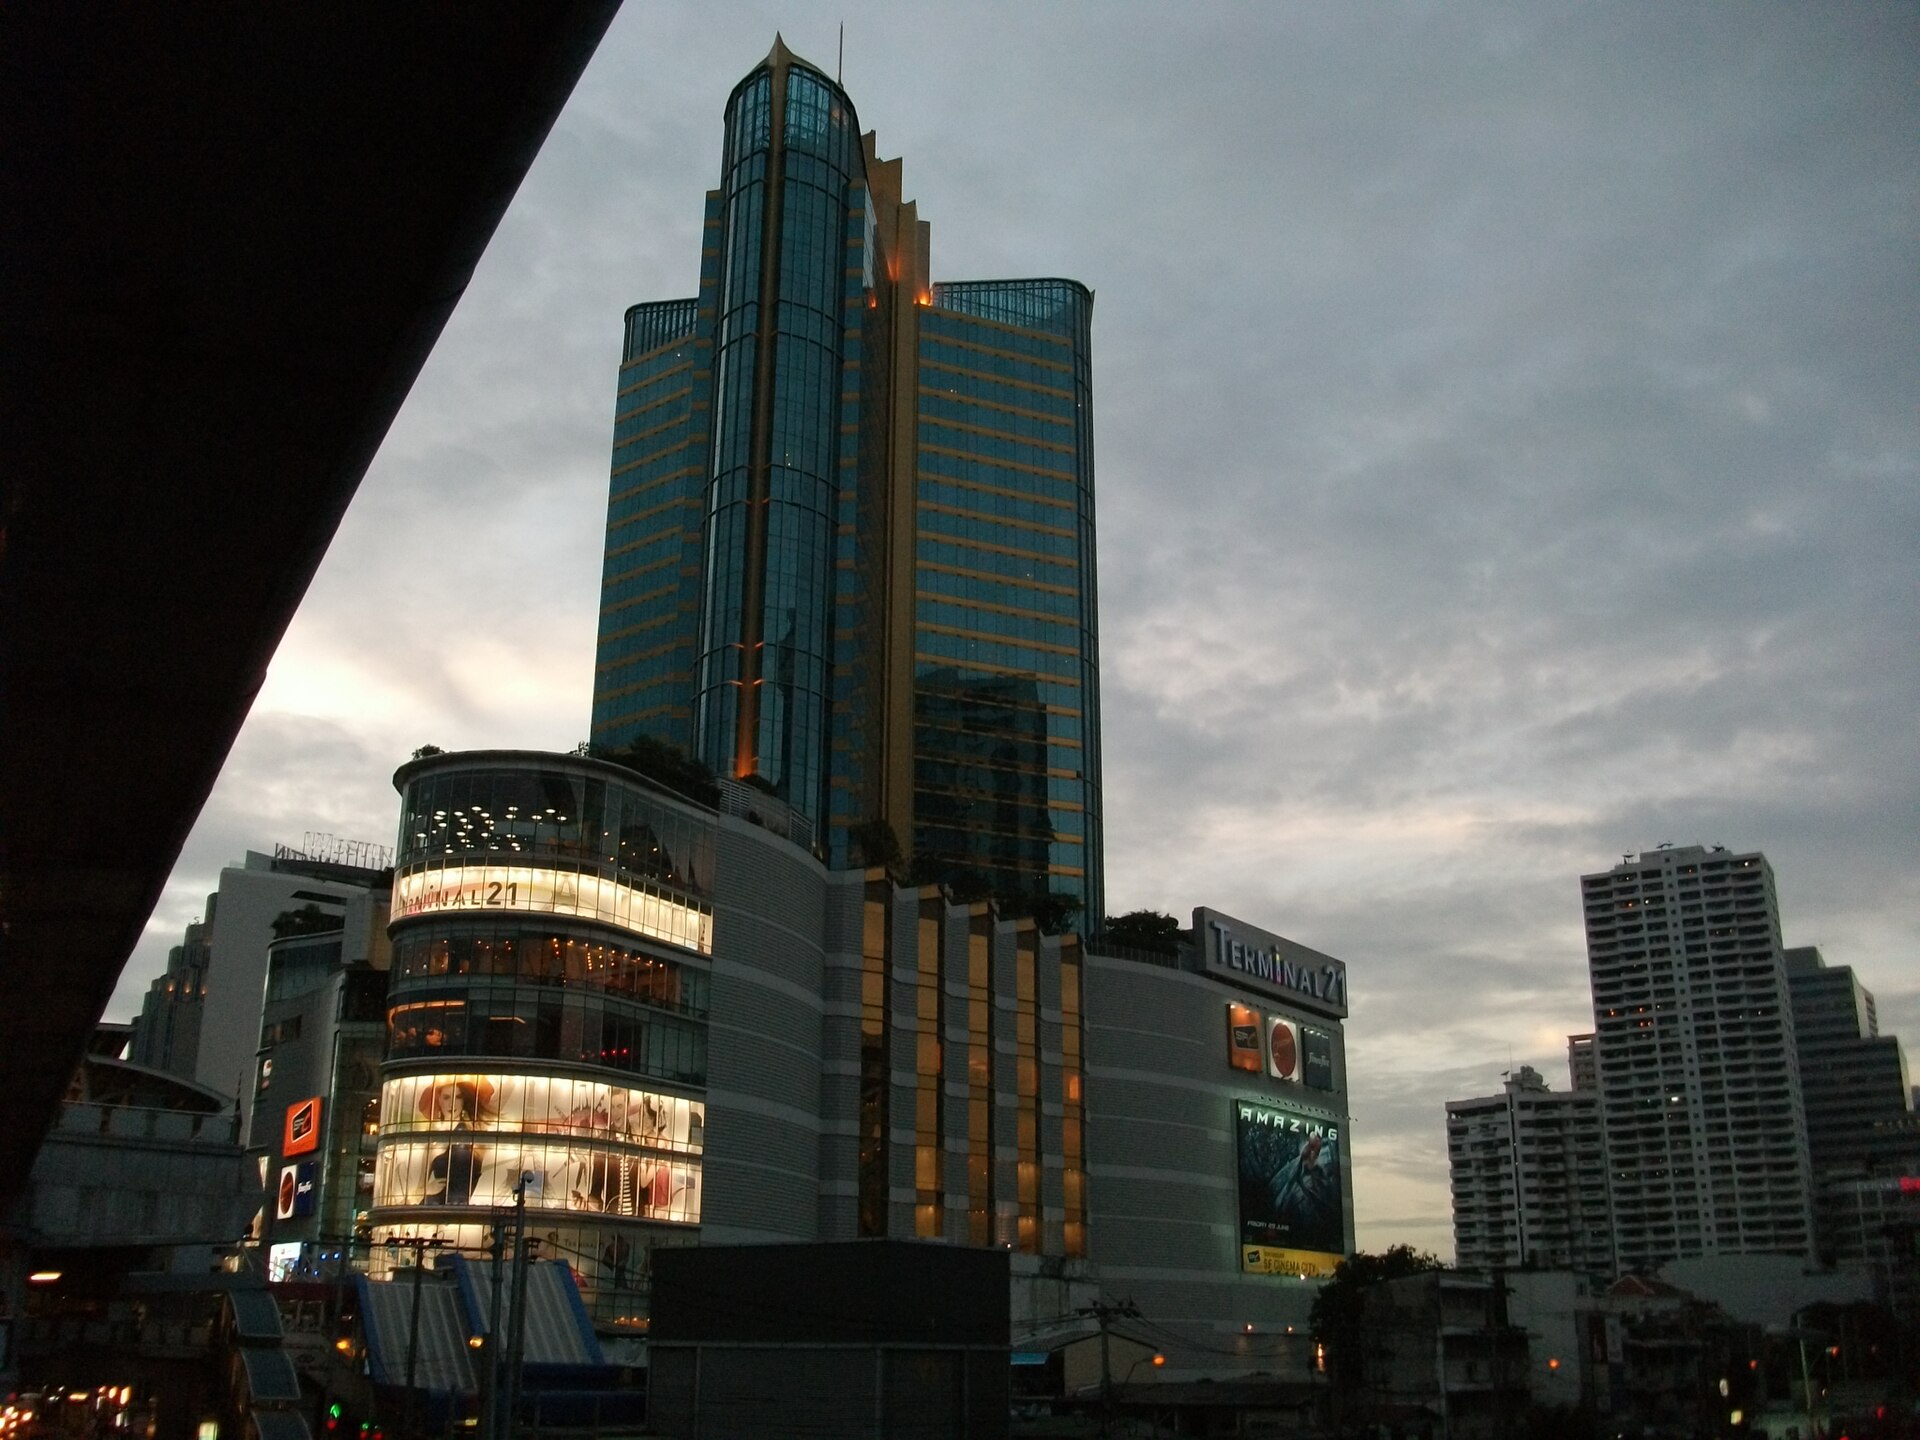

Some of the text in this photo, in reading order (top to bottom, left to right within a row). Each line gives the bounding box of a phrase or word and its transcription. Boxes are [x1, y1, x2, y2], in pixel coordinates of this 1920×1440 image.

[486, 881, 518, 906] 21
[1211, 920, 1346, 1007] TERMINAL 21
[1240, 1107, 1338, 1141] AMAZING
[1273, 1259, 1299, 1272] CINEMA
[1301, 1262, 1316, 1273] CITY
